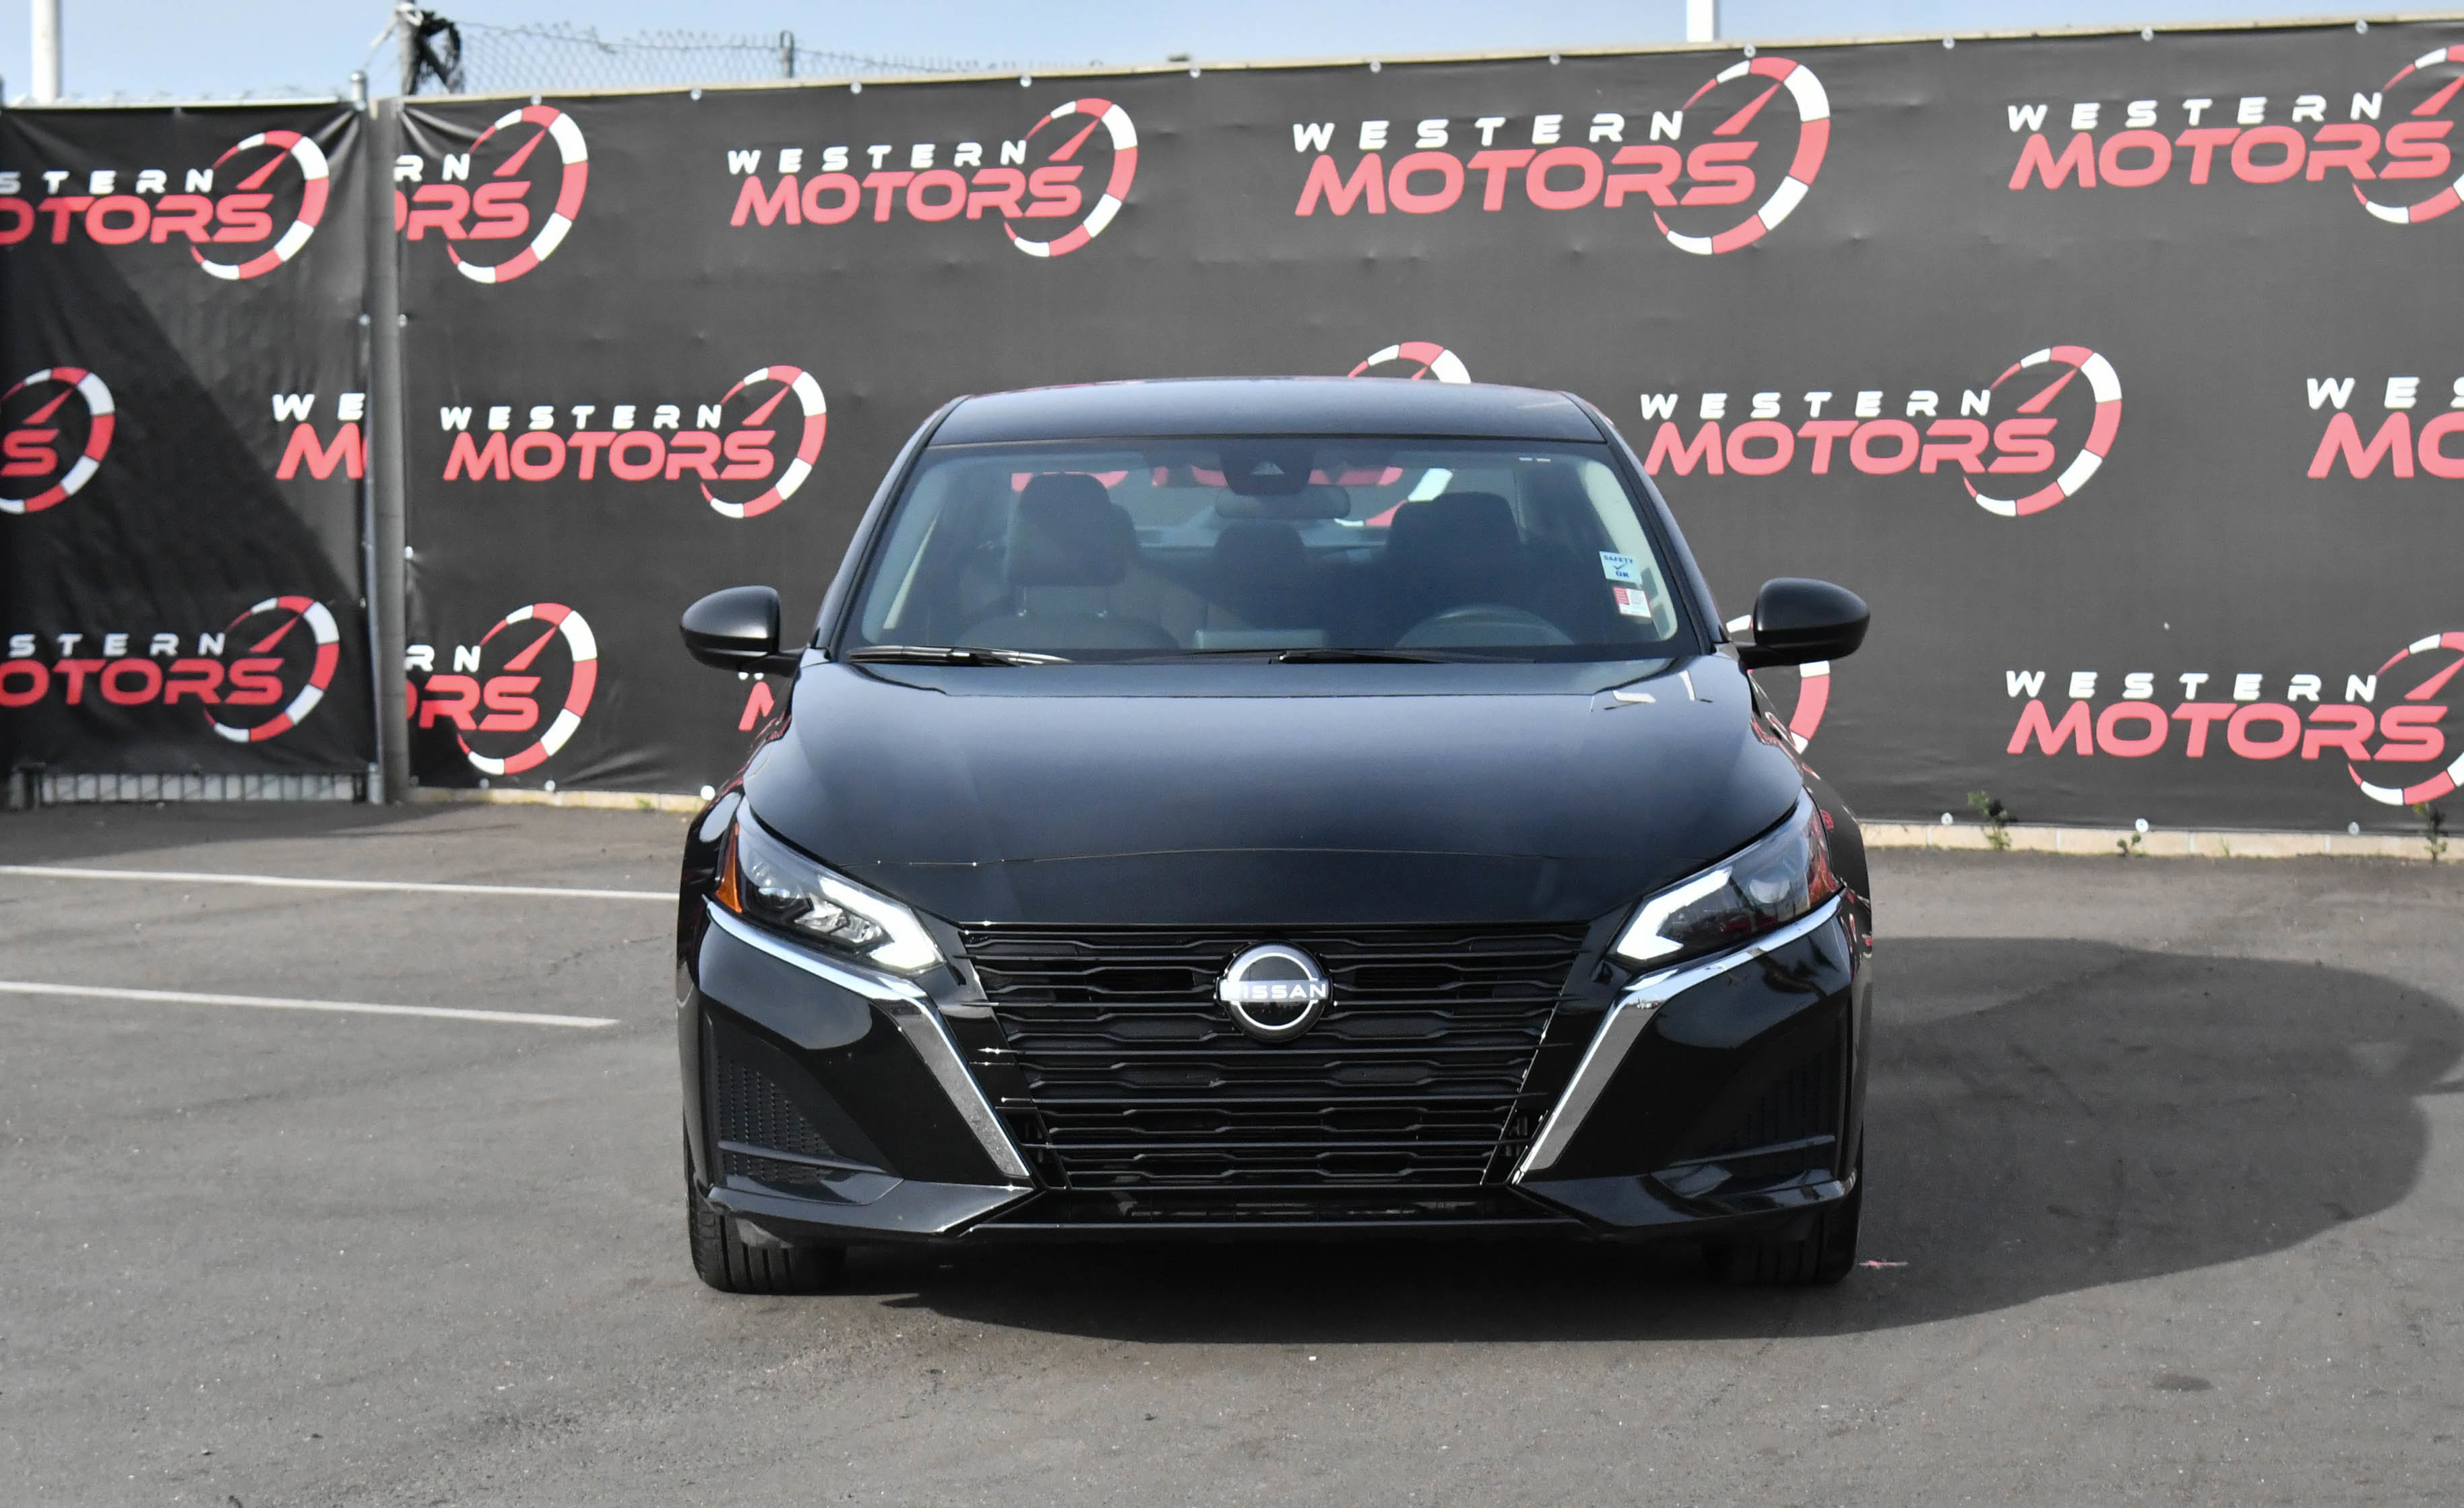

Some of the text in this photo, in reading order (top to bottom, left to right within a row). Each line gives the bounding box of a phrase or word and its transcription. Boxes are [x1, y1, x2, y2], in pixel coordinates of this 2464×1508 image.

[1292, 109, 1684, 153] WESTERN
[2007, 92, 2384, 133] WESTERN
[727, 139, 1027, 176] WESTERN
[2008, 120, 2455, 190] MOTORS
[730, 165, 1085, 227] MOTORS
[1294, 141, 1759, 216] MOTORS
[440, 404, 723, 431] WESTERN
[1639, 388, 1992, 421] WESTERN
[443, 430, 777, 482] MOTORS
[1643, 418, 2059, 476] MOTORS
[1604, 555, 1633, 564] SAFETY
[9, 633, 225, 658] STERN
[2005, 669, 2378, 703] WESTERN
[2006, 699, 2449, 762] MOTORS
[1222, 983, 1326, 999] ISSAN
